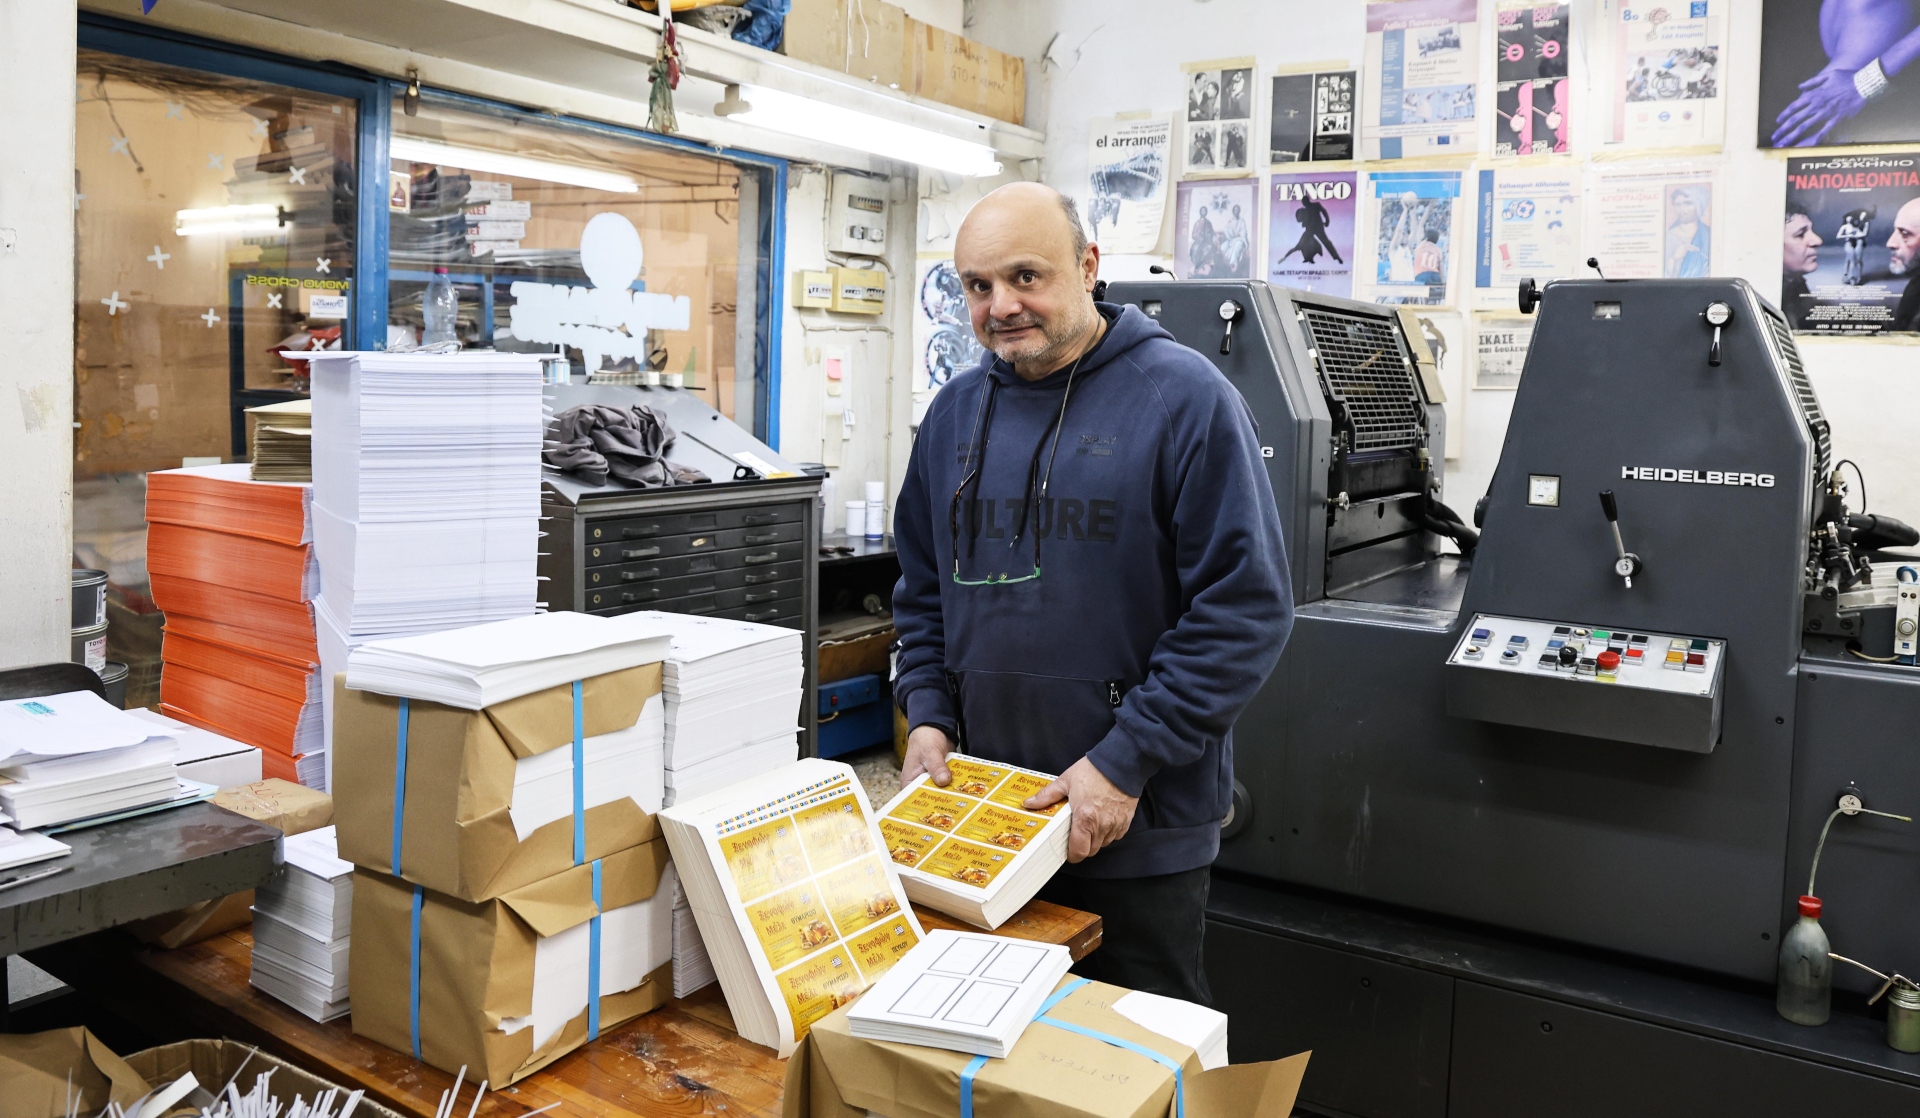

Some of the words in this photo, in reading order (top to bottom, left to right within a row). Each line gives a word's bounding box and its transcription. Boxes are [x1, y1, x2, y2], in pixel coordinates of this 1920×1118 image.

[1096, 134, 1107, 147] el
[1111, 133, 1166, 149] arranque
[1801, 159, 1914, 170] ΠΡΟΣΚΗΝΙΟ
[1275, 181, 1352, 201] TANGO
[1478, 333, 1515, 346] ΣΚΑΣΕ
[1621, 466, 1775, 488] HEIDELBERG
[89, 639, 103, 647] TOYO
[970, 859, 992, 868] ΠΕΥΚΟΥ
